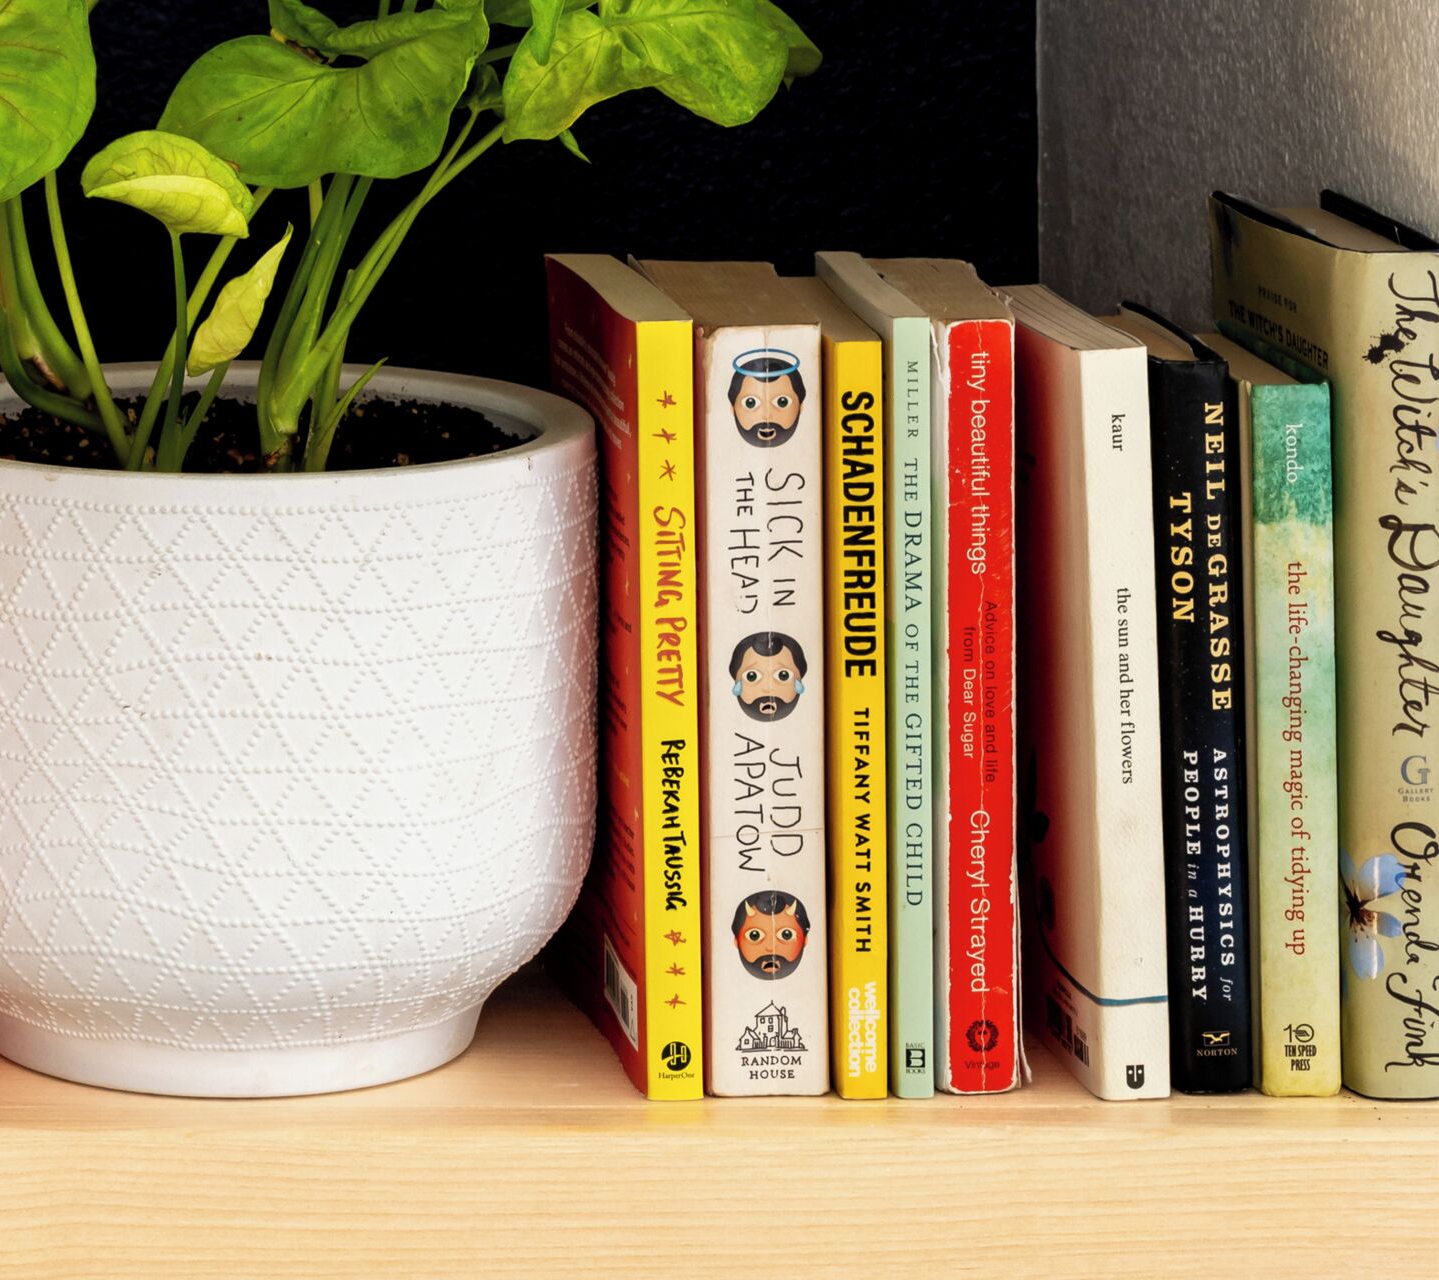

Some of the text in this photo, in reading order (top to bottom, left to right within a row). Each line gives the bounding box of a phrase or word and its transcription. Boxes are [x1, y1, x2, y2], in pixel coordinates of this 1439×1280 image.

[907, 361, 918, 438] MILLER
[967, 351, 990, 575] tiny beautiful things
[1111, 414, 1125, 451] kaur
[1285, 423, 1303, 484] kondo
[841, 391, 877, 678] SCHADENFREUDE
[1170, 492, 1194, 622] TYSON
[904, 458, 923, 906] THE DRAMA OF THE GIFTED CHILD
[1116, 587, 1135, 786] the sun and her flowers
[734, 733, 765, 872] APATOW
[769, 748, 803, 856] JUDD
[1282, 561, 1311, 957] the life-changing magic of tidying up
[854, 708, 871, 953] TIFFANY WATT SMITH
[1213, 748, 1235, 967] ASTROPHYSICS
[970, 810, 990, 992] Cheryl Strayed
[741, 1056, 802, 1066] RANDOM
[749, 1070, 795, 1080] HOUSE
[1196, 1048, 1238, 1056] NORTON
